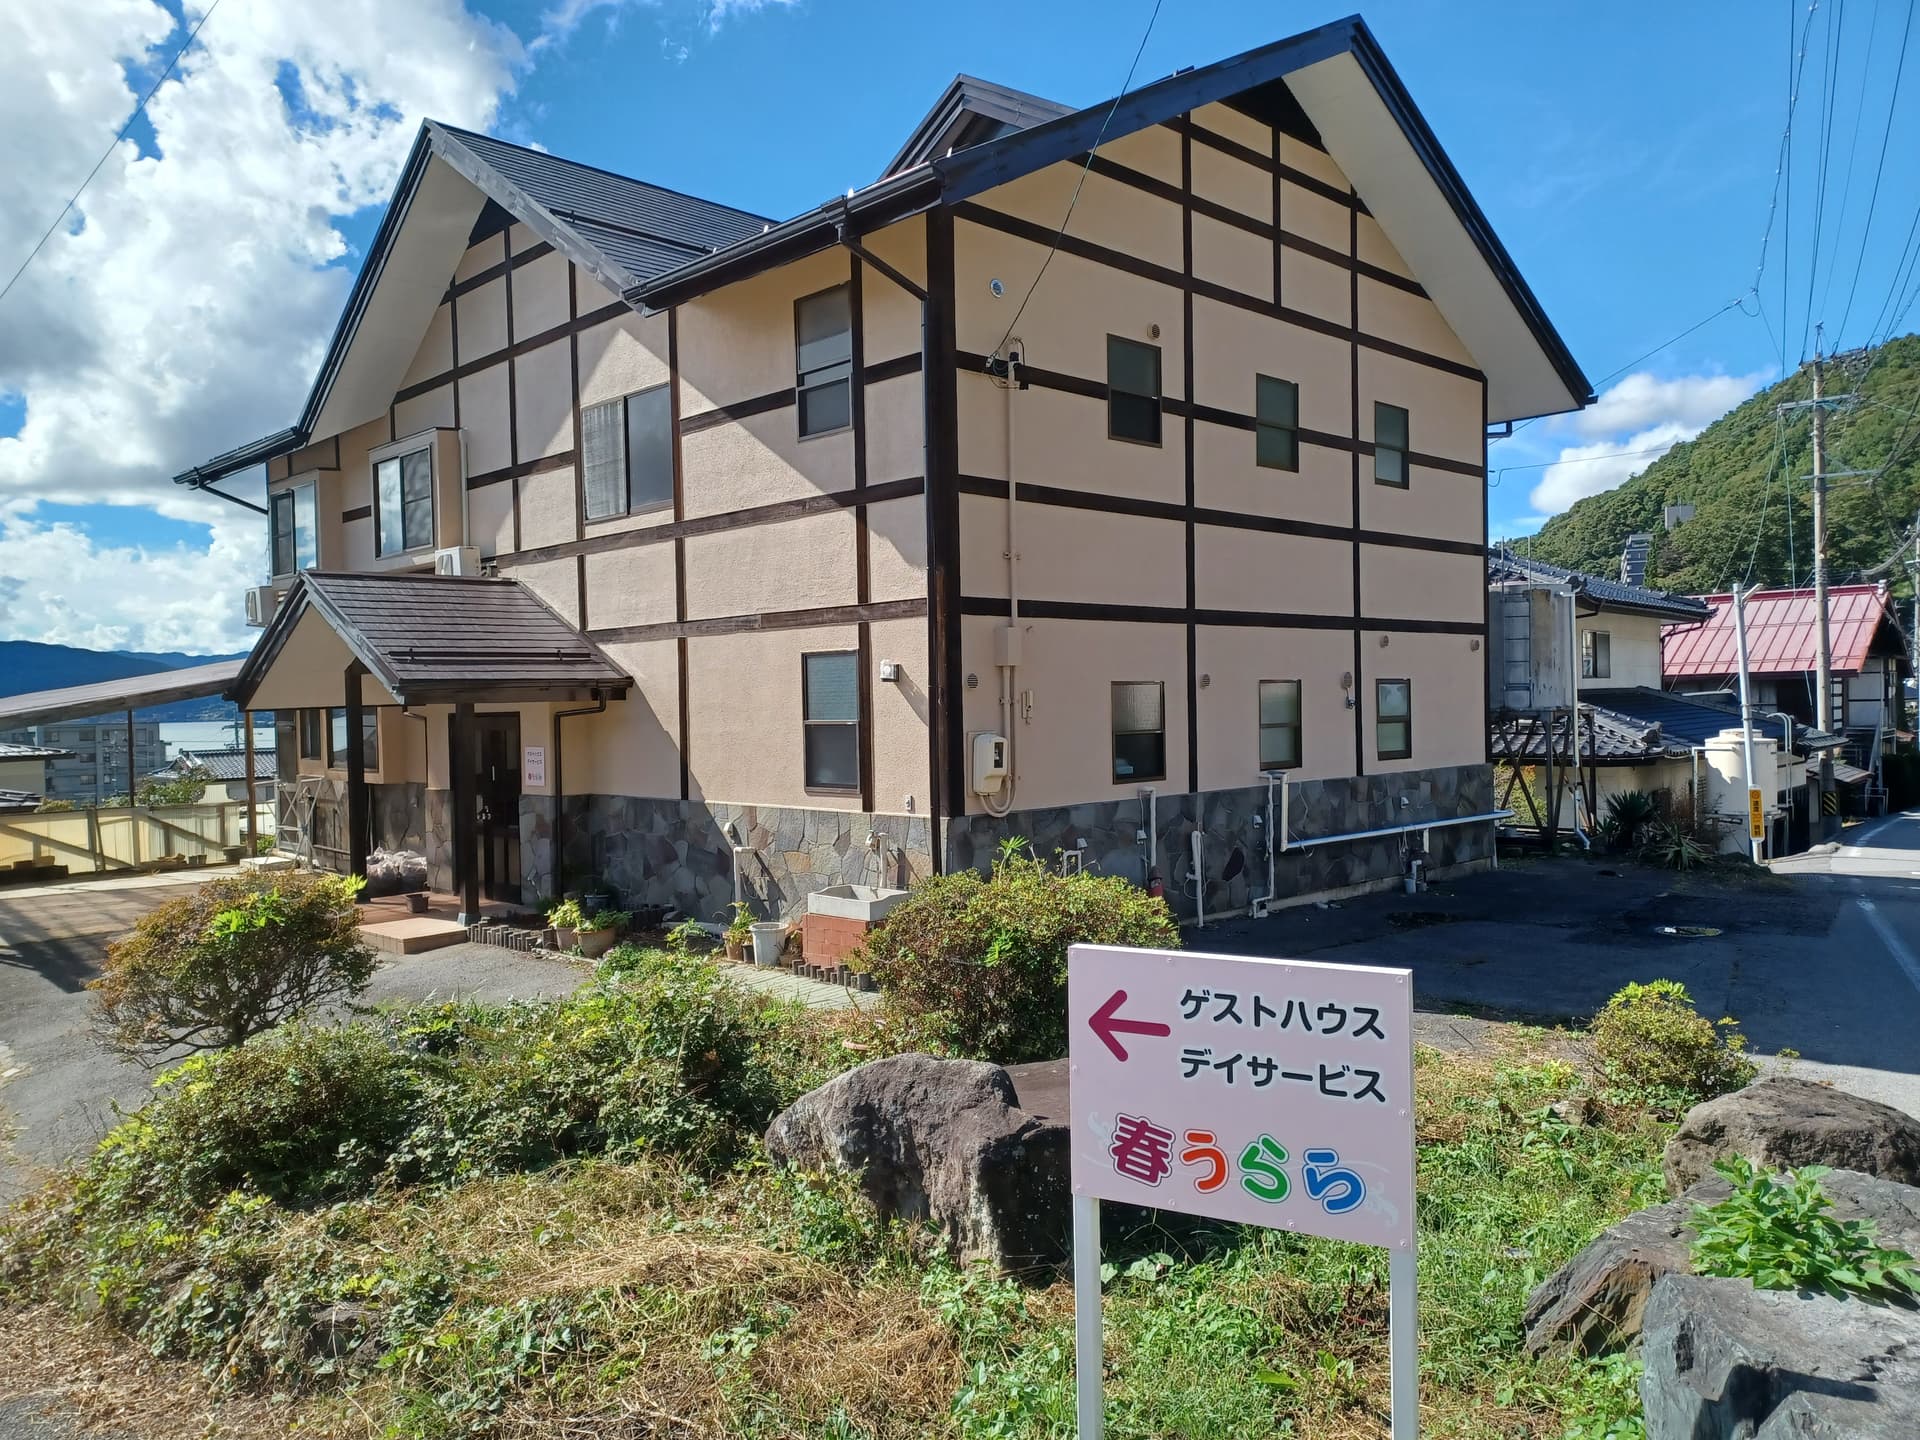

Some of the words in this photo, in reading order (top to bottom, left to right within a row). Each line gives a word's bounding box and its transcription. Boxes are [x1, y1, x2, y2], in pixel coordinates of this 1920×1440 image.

[1180, 988, 1385, 1040] ゲストハウス
[1181, 1048, 1386, 1102] デイサービス
[1108, 1113, 1366, 1215] 春うらら
